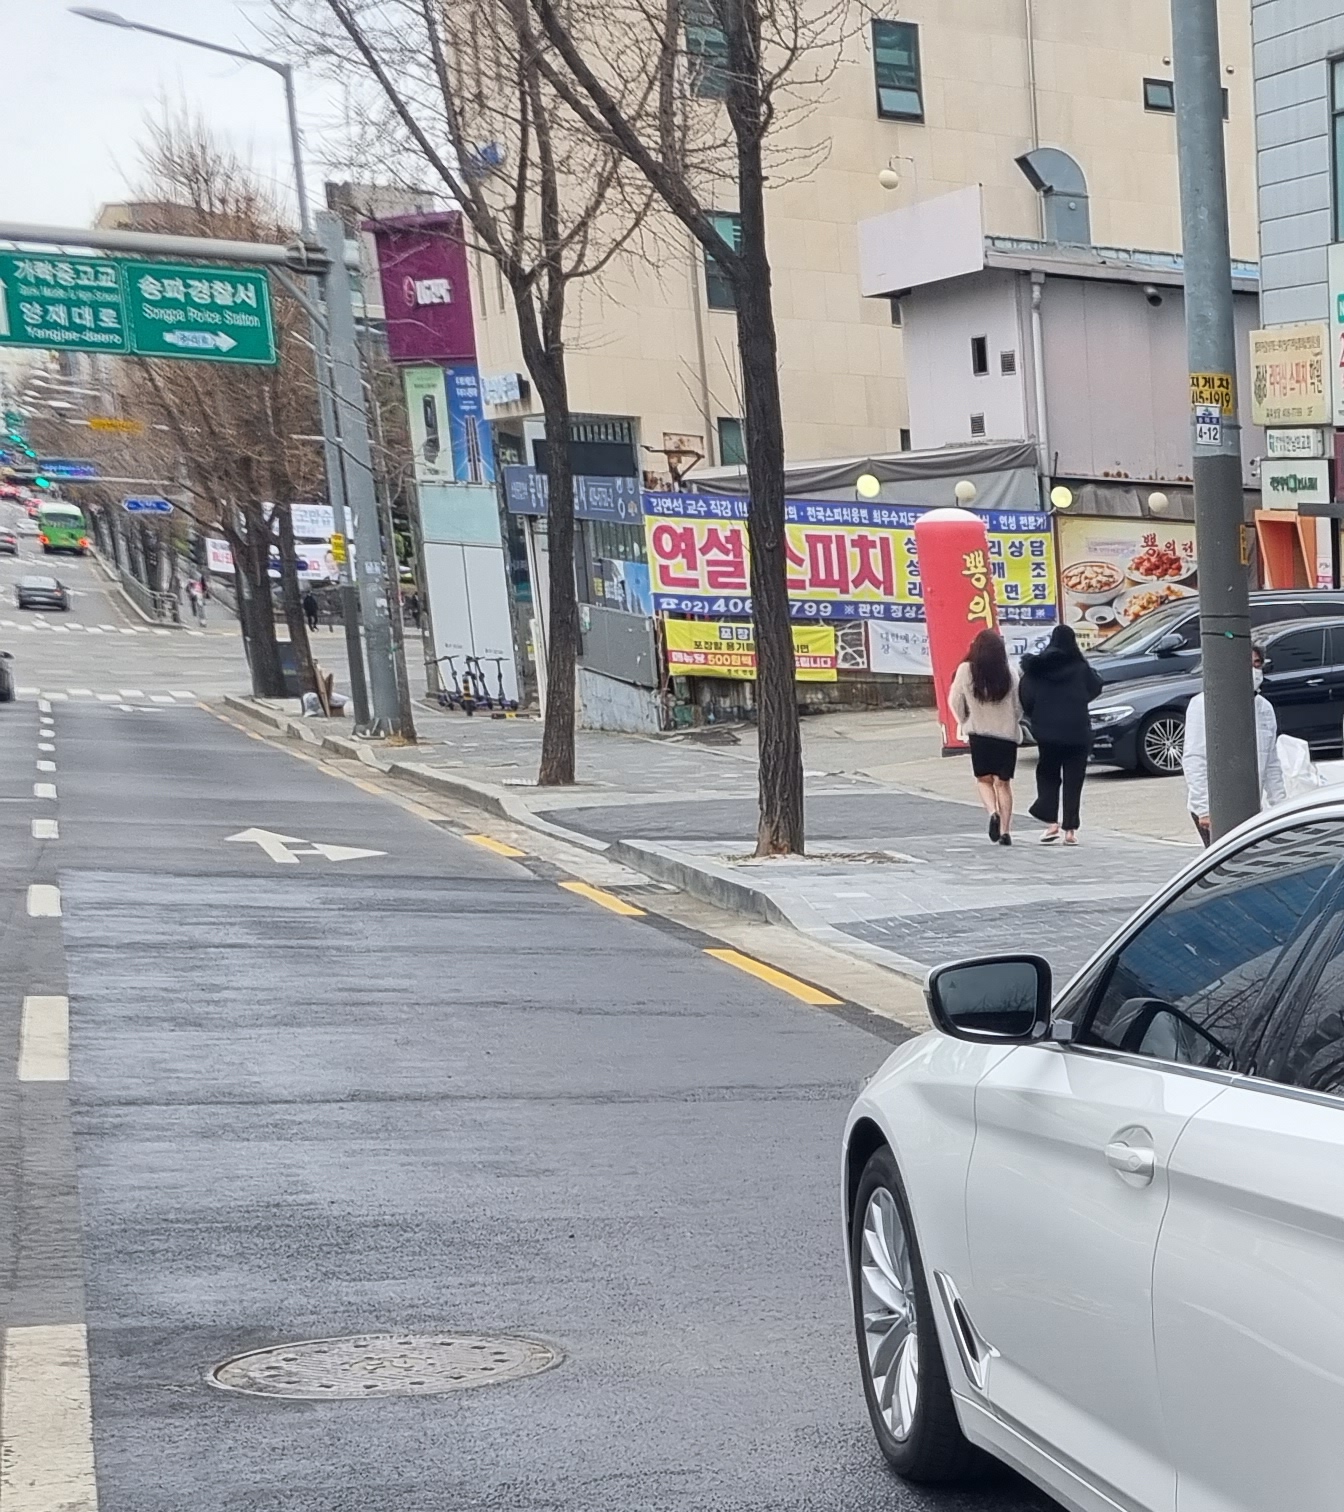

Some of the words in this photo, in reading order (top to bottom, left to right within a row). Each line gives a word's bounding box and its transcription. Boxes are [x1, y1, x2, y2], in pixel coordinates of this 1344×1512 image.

[13, 259, 118, 288] 가락중고교
[137, 274, 257, 308] 송파경찰서
[19, 301, 121, 328] 양재대로
[142, 303, 186, 325] Songpa
[187, 306, 222, 325] Police
[223, 310, 260, 327] Station
[1190, 377, 1229, 390] 지게차
[1198, 426, 1218, 441] 4-12
[651, 498, 683, 515] 김연석
[686, 500, 707, 516] 교수
[710, 501, 732, 517] 직강
[999, 515, 1017, 531] 인성
[652, 523, 747, 591] 연설
[858, 604, 885, 618] 관인
[693, 640, 723, 651] 포장할
[707, 653, 753, 666] 500원씩
